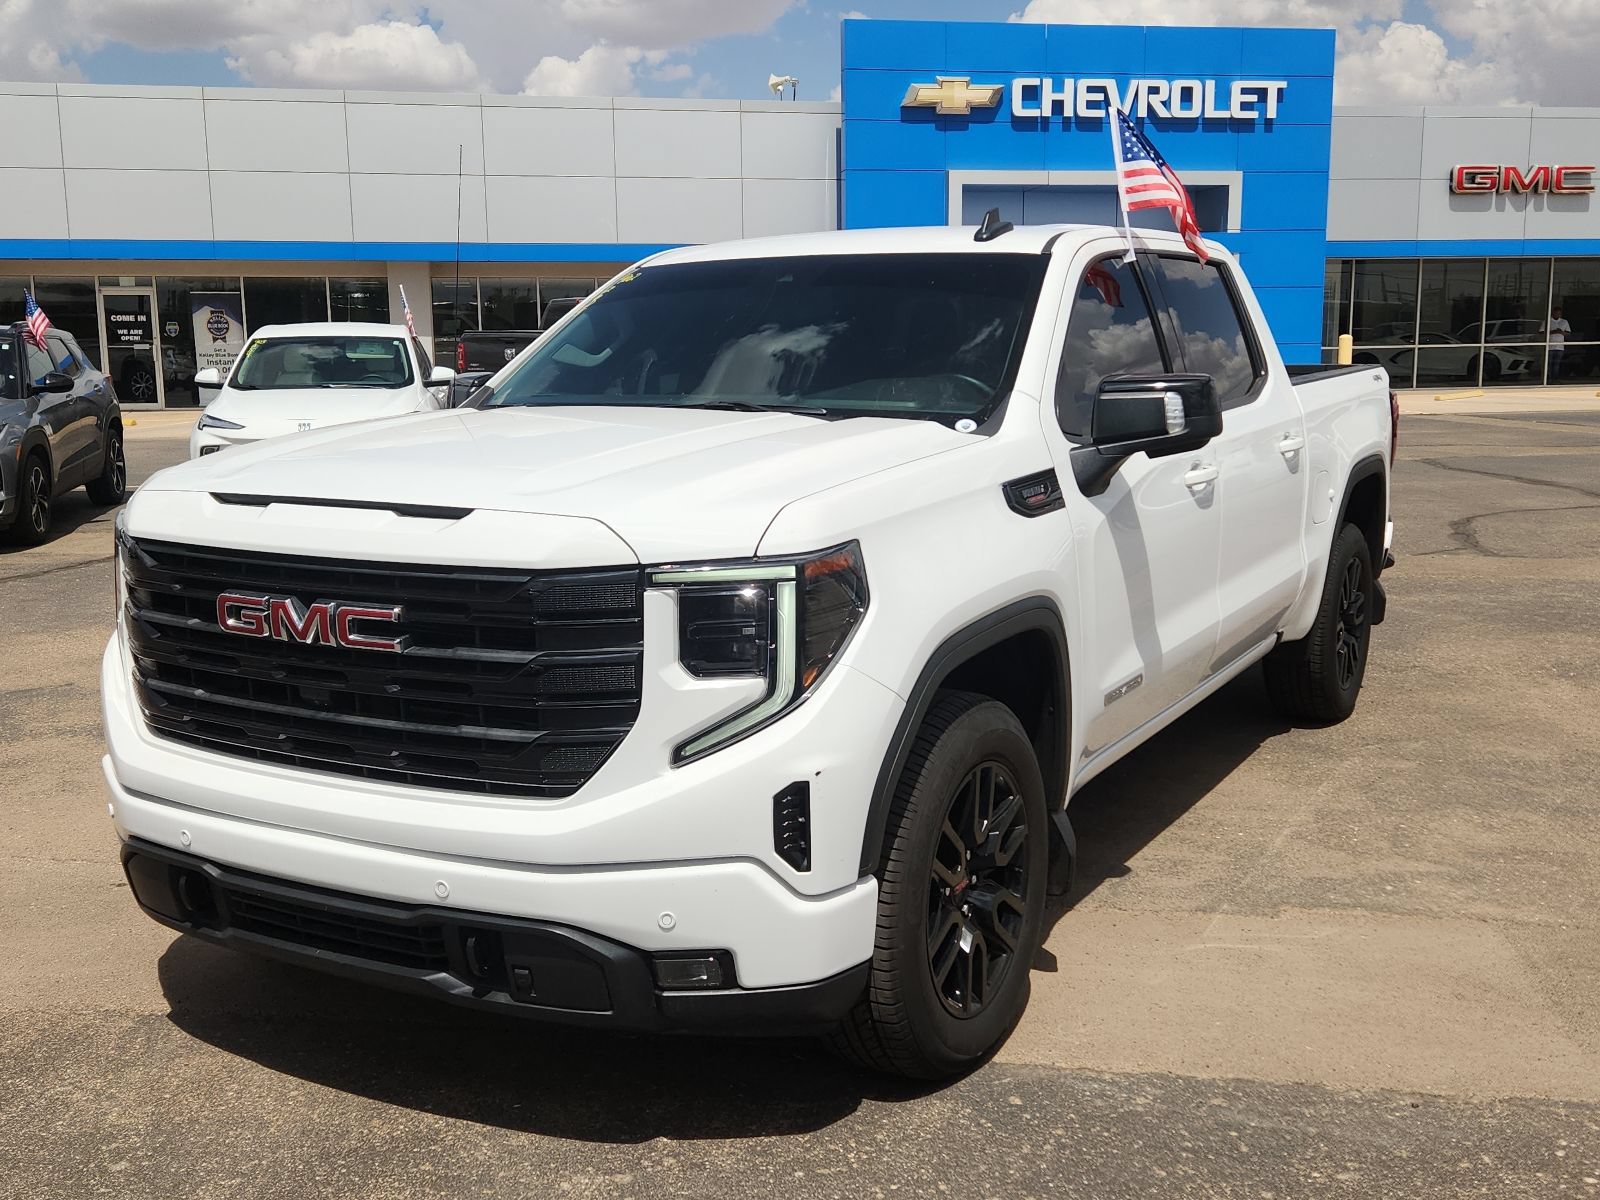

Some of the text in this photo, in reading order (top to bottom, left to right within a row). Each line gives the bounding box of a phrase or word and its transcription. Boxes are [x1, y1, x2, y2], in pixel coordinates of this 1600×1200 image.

[1011, 77, 1288, 119] CHEVROLET
[1451, 164, 1597, 194] GMC
[110, 314, 147, 322] COME IN
[217, 589, 409, 654] GMC
